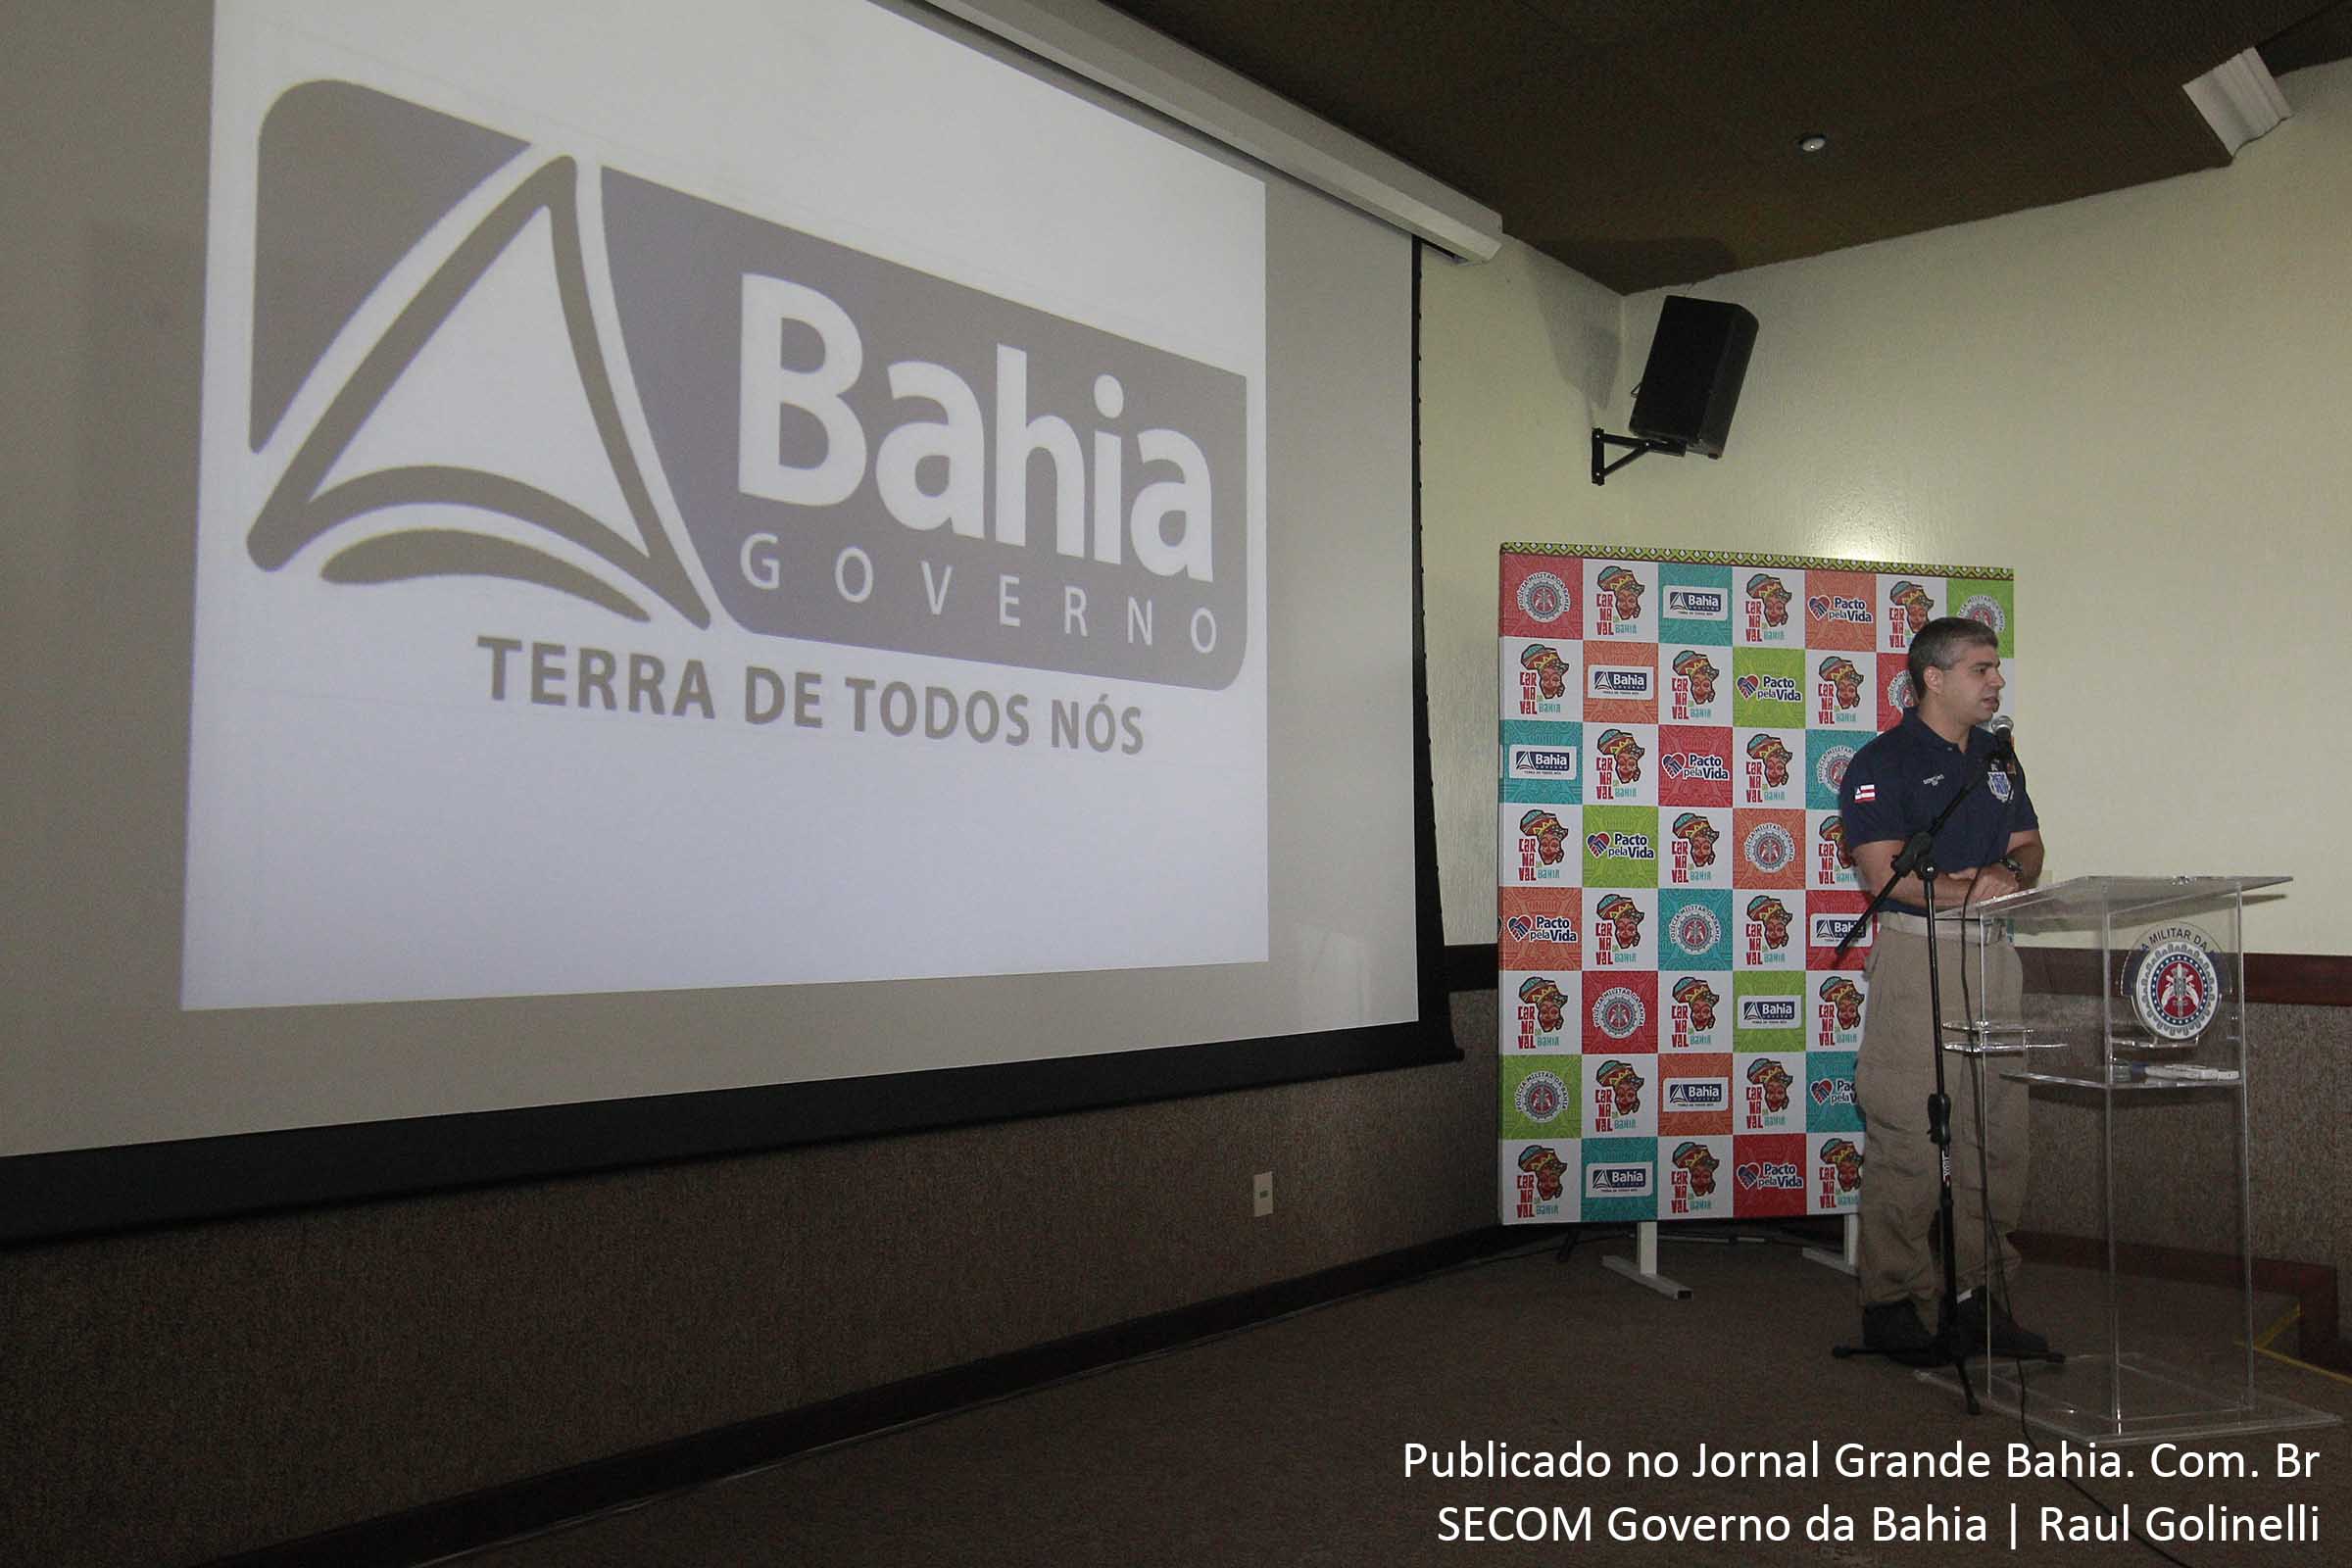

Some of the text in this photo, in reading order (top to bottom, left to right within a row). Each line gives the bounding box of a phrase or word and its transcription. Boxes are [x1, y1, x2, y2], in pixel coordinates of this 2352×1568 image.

[739, 272, 1214, 582] Bahia
[742, 532, 1216, 655] GOVERNO
[1689, 595, 1719, 607] Bahia
[1835, 597, 1865, 610] Pacto
[1829, 611, 1872, 622] pela Vida
[1613, 673, 1644, 685] Bahia
[1763, 676, 1794, 688] Pacto
[476, 635, 1144, 756] TERRA DE TODOS NÓS
[1757, 689, 1801, 701] pela Vida
[1536, 754, 1567, 764] Bahia
[1690, 755, 1721, 766] Pacto
[1684, 767, 1728, 779] pela Vida
[1615, 834, 1646, 846] Pacto
[1609, 847, 1654, 858] pela Vida
[1537, 916, 1569, 928] Pacto
[1530, 929, 1577, 941] pela Vida
[2149, 928, 2207, 951] MILITAR DA
[1762, 1004, 1792, 1014] Bahia
[1689, 1086, 1720, 1097] Bahia
[1837, 1080, 1855, 1092] Pac
[1765, 1163, 1795, 1175] Pacto
[1612, 1171, 1643, 1183] Bahia
[1758, 1175, 1802, 1187] pela Vida
